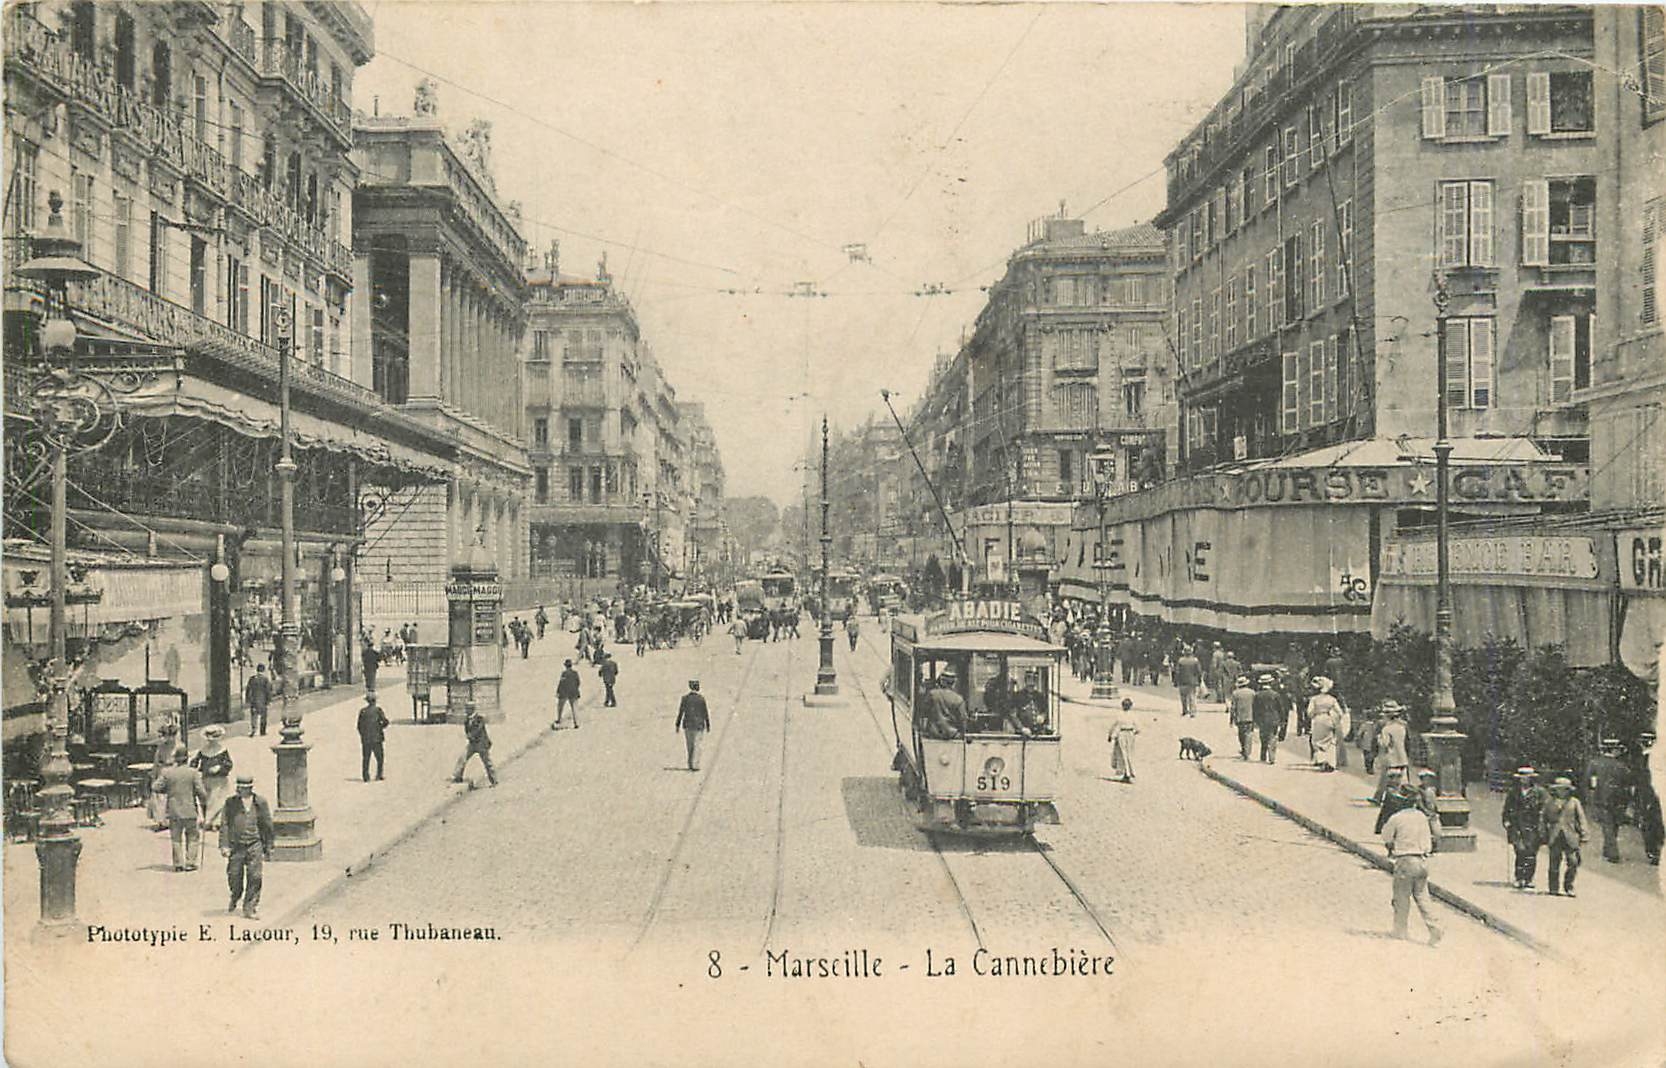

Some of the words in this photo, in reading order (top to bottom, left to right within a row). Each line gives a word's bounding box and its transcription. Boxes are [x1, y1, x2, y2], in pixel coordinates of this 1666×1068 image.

[1453, 468, 1590, 499] CAF
[1520, 541, 1577, 575] BAR
[949, 600, 1021, 621] ABADIE
[977, 776, 1011, 791] 519
